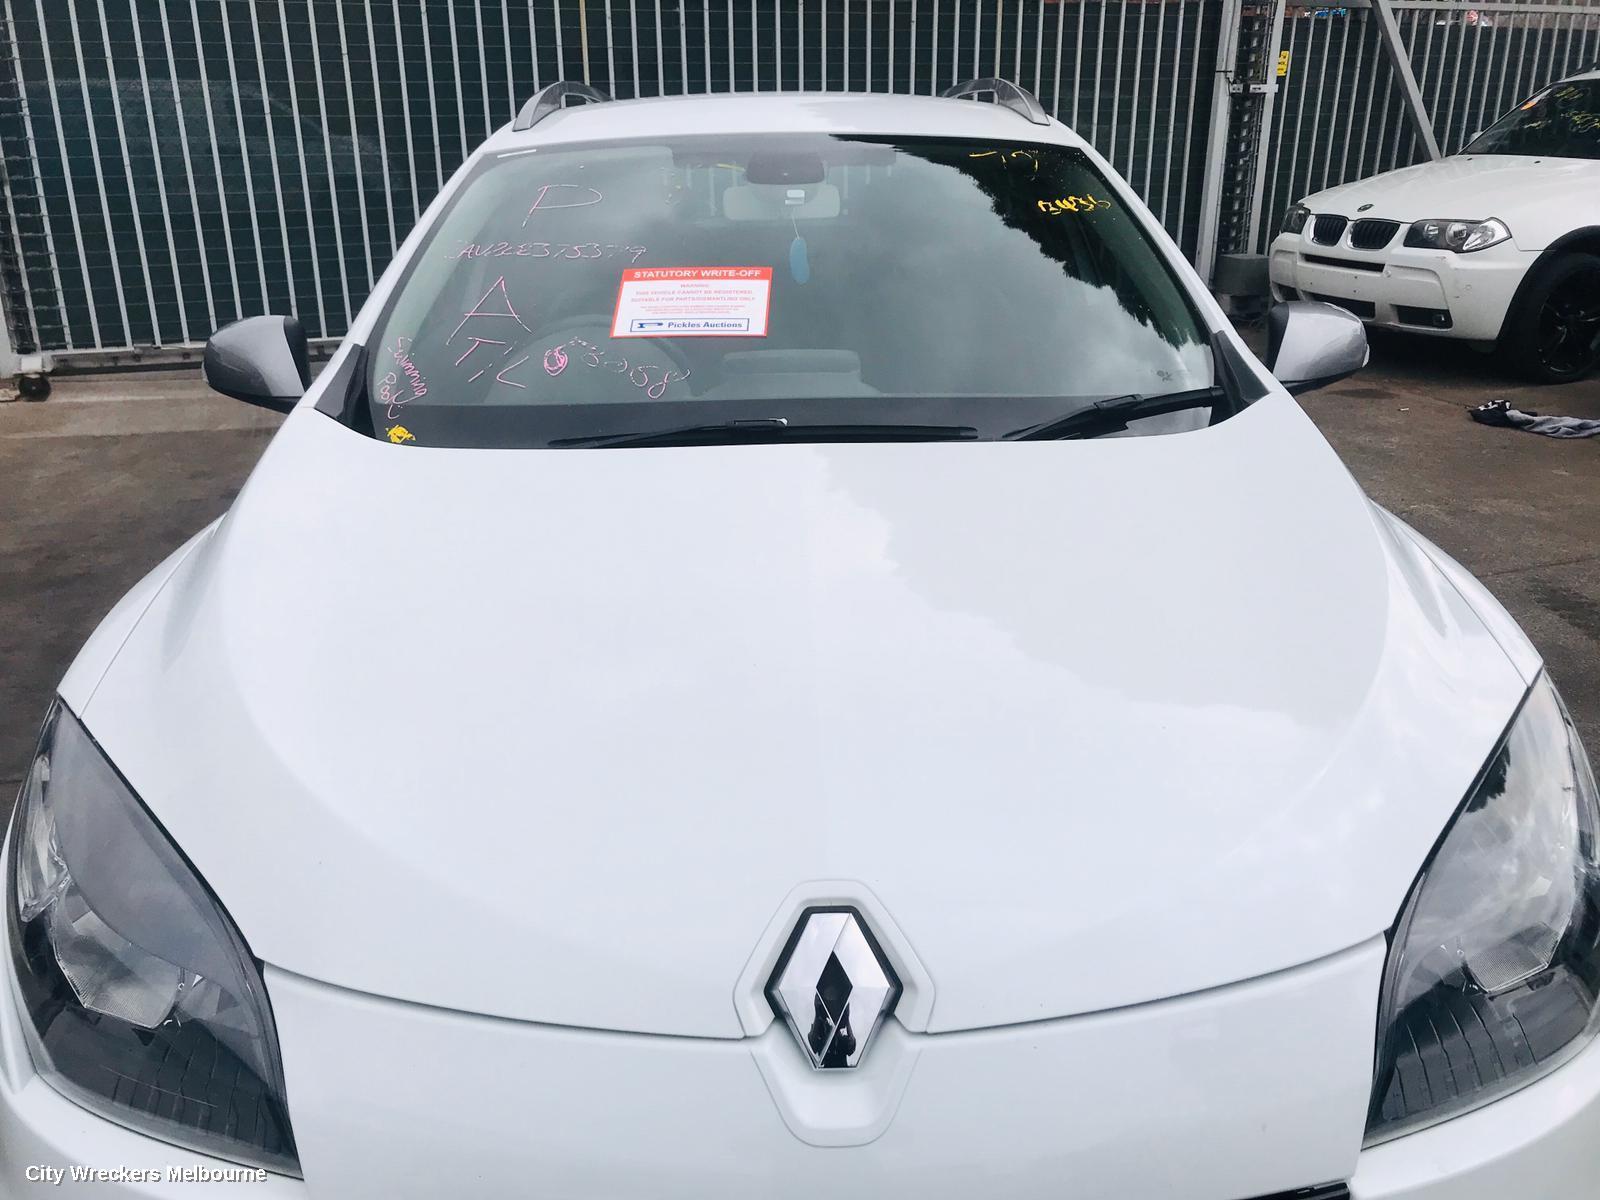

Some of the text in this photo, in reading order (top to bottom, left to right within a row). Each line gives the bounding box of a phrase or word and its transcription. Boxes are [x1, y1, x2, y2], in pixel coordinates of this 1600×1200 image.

[633, 269, 762, 279] STATUTORY WRITE-OFF
[446, 275, 535, 346] A
[667, 321, 701, 329] Pickles
[702, 321, 743, 329] Auctions
